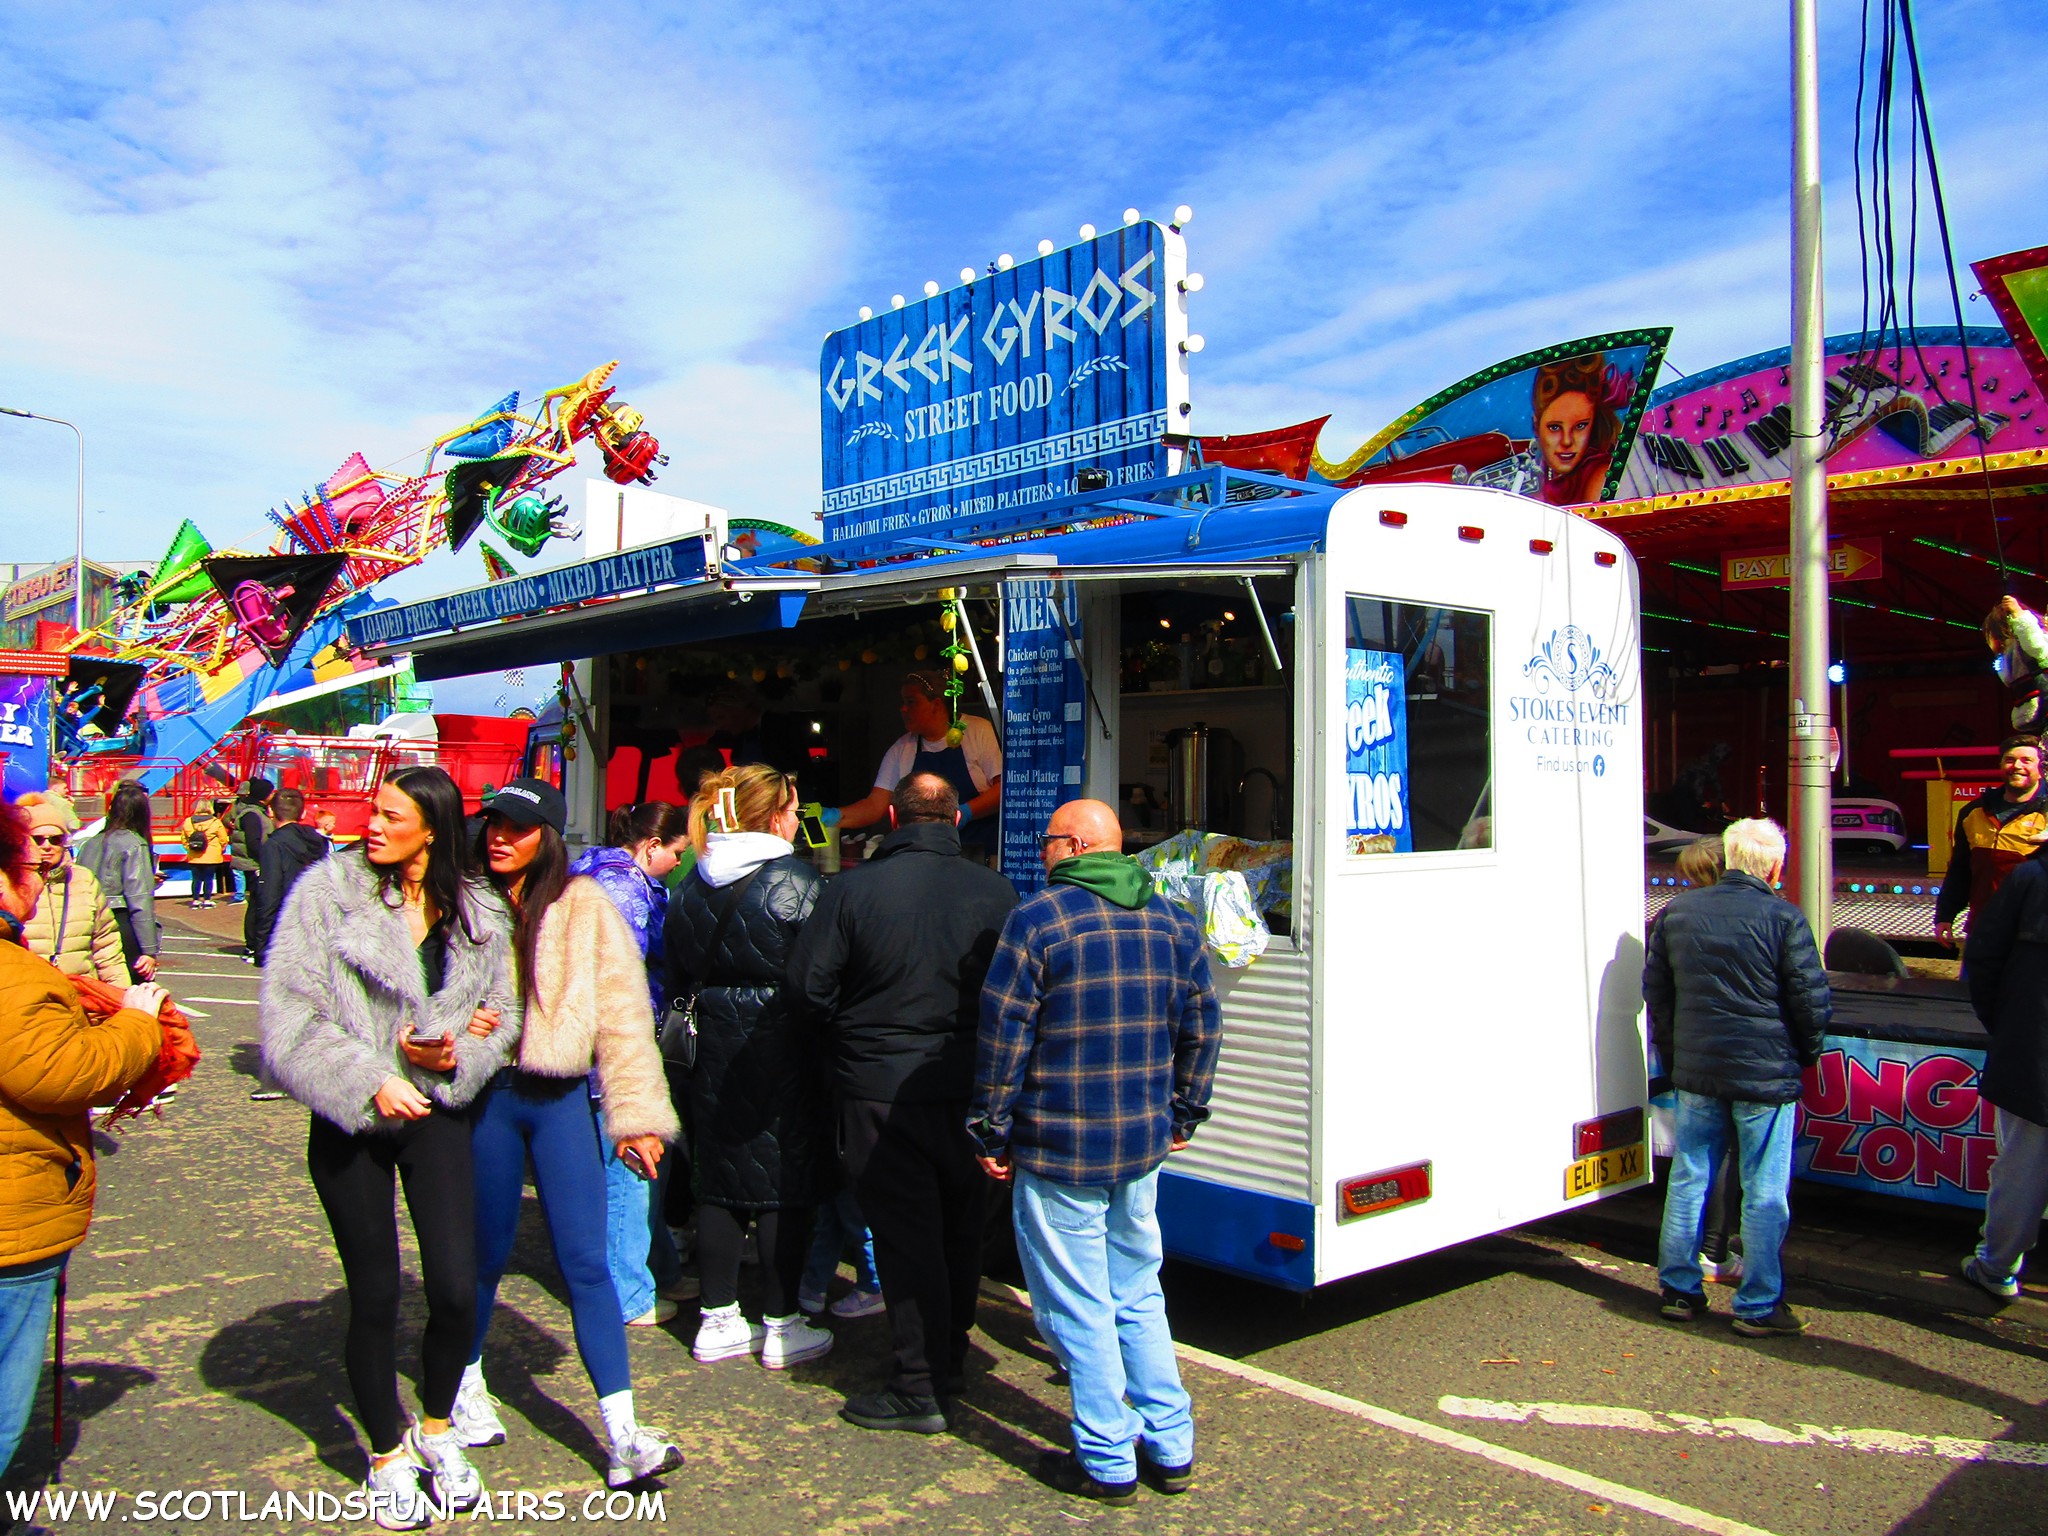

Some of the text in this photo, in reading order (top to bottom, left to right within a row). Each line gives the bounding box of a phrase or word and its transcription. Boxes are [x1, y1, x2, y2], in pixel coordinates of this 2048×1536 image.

[826, 250, 1156, 413] GREEK GYROS
[904, 372, 1053, 443] STREET FOOD
[833, 461, 1155, 541] HALLOUMI FRIES GYROS MIXED PLATTERS LOD FRIES
[1734, 558, 1777, 580] PAY
[360, 545, 676, 643] LOADED FRIES GREEK GYROS MIXED PLATTER
[1009, 597, 1078, 633] MENU
[1007, 645, 1059, 662] Chicken Gyro
[1053, 673, 1064, 683] and
[1345, 655, 1395, 684] uthentic
[1007, 708, 1051, 723] Doner Gyro
[1345, 683, 1394, 752] eek
[1509, 697, 1629, 725] STOKES EVENT
[1032, 725, 1047, 734] bread
[1048, 724, 1062, 733] filled
[1527, 726, 1614, 748] CATERING
[1537, 755, 1560, 772] Find
[1562, 760, 1574, 772] us
[1576, 761, 1590, 772] on
[1006, 769, 1060, 783] Mixed Platter
[1026, 787, 1047, 796] chicken
[1047, 787, 1058, 796] and
[1954, 786, 1976, 797] ALL
[1028, 799, 1041, 808] with
[1019, 811, 1029, 819] and
[1030, 811, 1043, 820] pitta
[1043, 811, 1053, 819] bre
[1004, 831, 1033, 844] Loaded
[1797, 1050, 1995, 1136] UNG
[1620, 1149, 1637, 1177] XX
